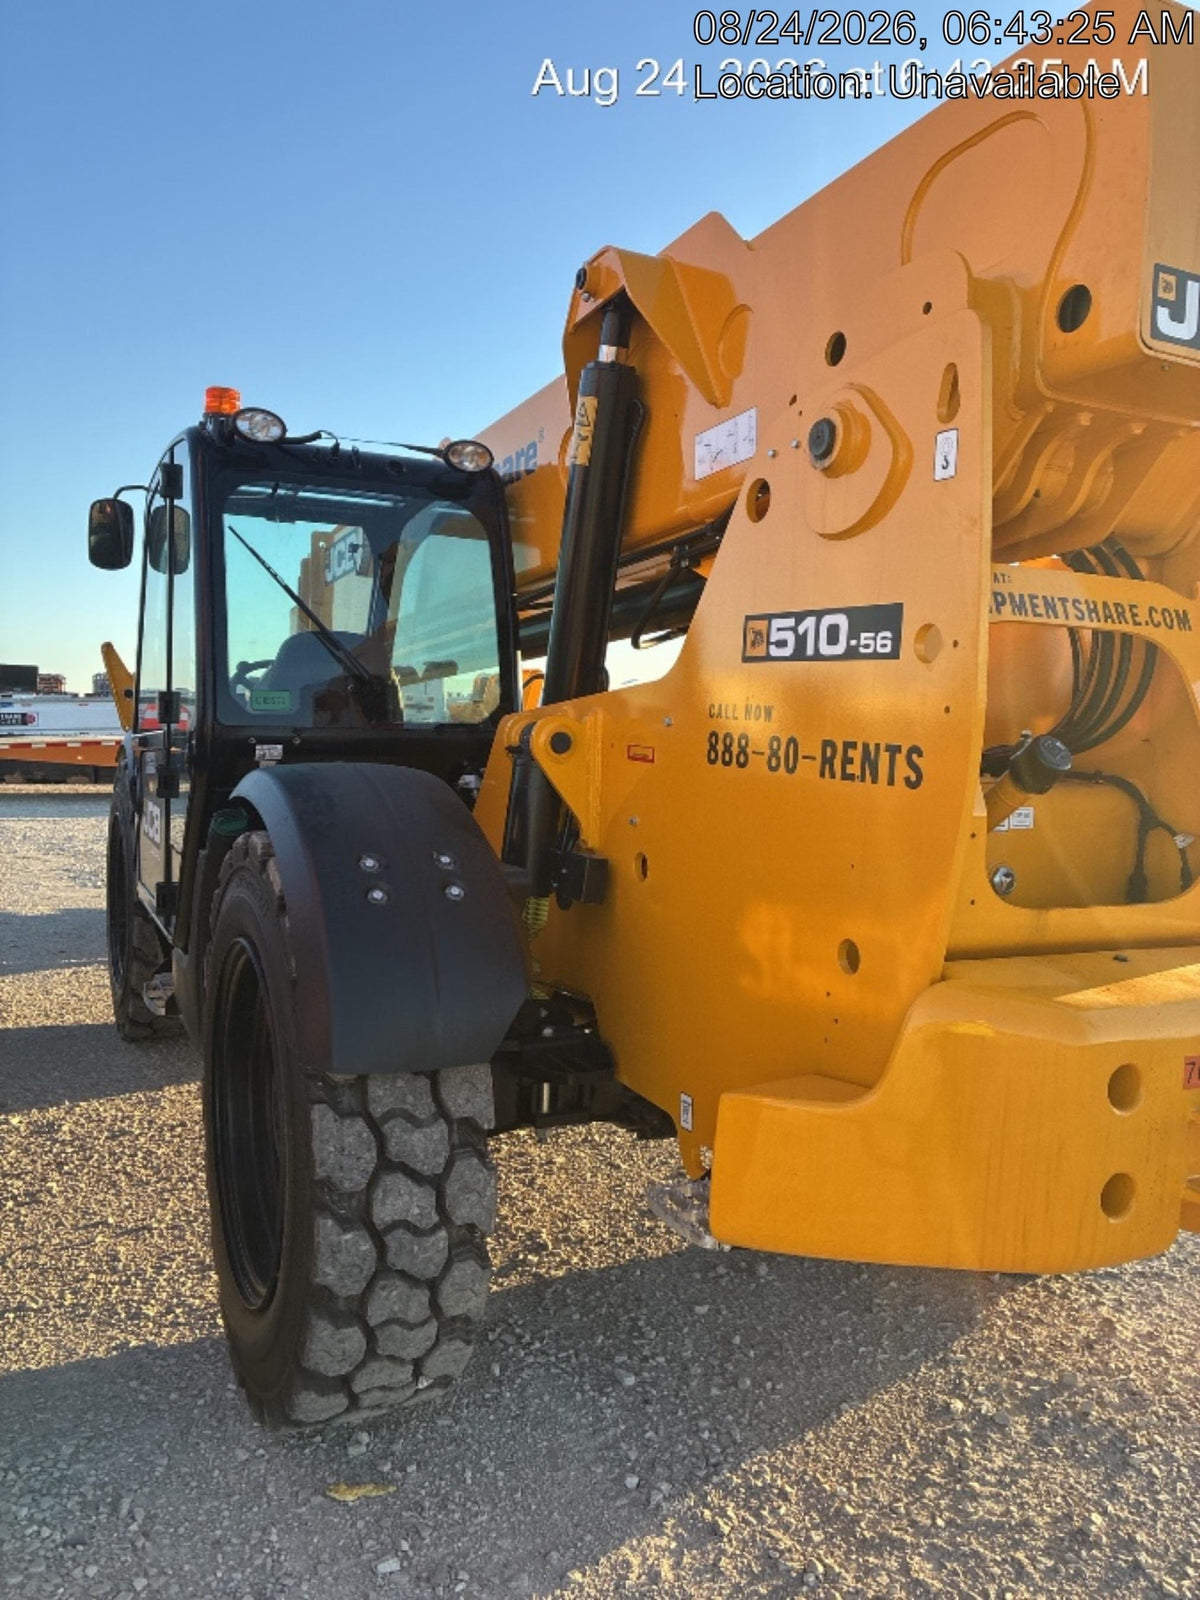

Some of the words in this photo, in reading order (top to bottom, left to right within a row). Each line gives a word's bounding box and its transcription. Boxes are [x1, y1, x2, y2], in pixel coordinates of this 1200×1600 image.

[495, 440, 537, 484] are
[989, 591, 1192, 632] PMENTSHARE.COM
[709, 703, 738, 721] CALL
[744, 703, 774, 723] NOW
[707, 730, 924, 790] 888-80-RENTS
